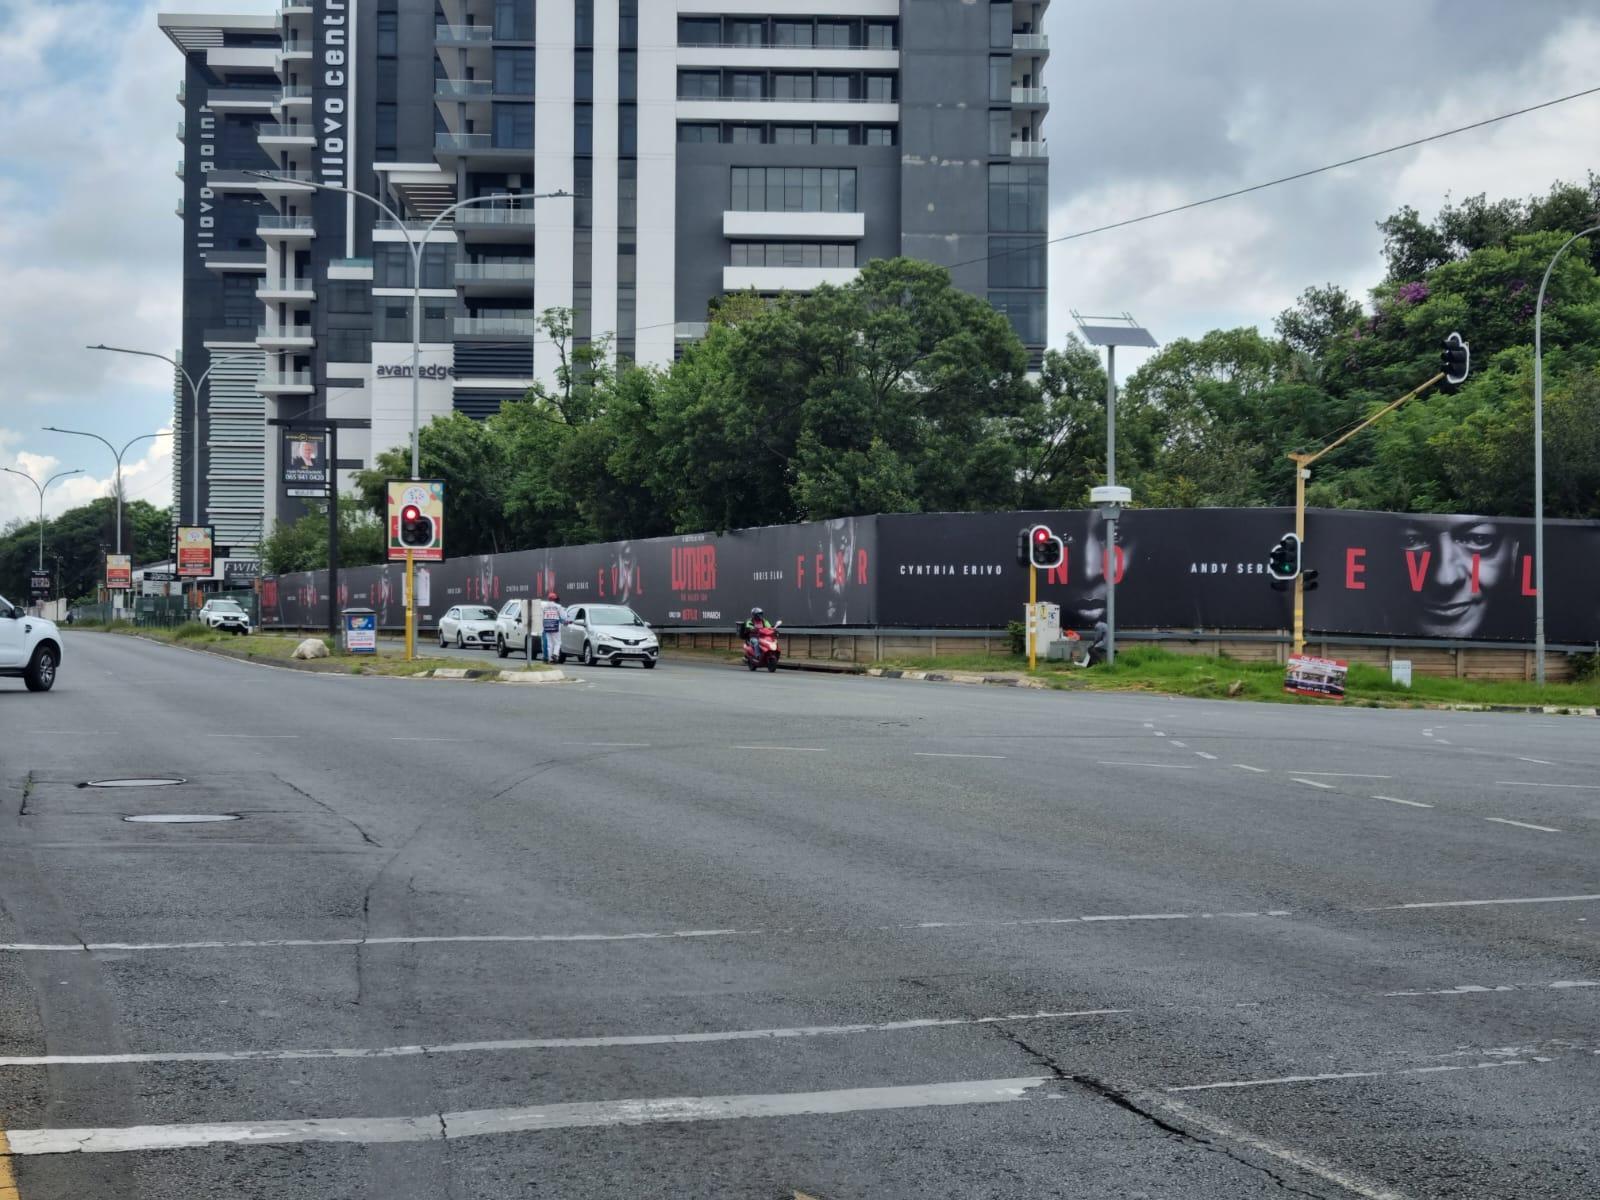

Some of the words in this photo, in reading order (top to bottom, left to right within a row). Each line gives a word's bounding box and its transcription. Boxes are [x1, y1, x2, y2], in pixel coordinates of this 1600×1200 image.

[672, 545, 716, 591] LUTHER
[796, 548, 869, 589] FEAR
[899, 564, 955, 576] CYNTHIA
[963, 564, 1003, 576] ERIVO
[1190, 562, 1228, 574] ANDY
[1345, 547, 1538, 597] EVIL
